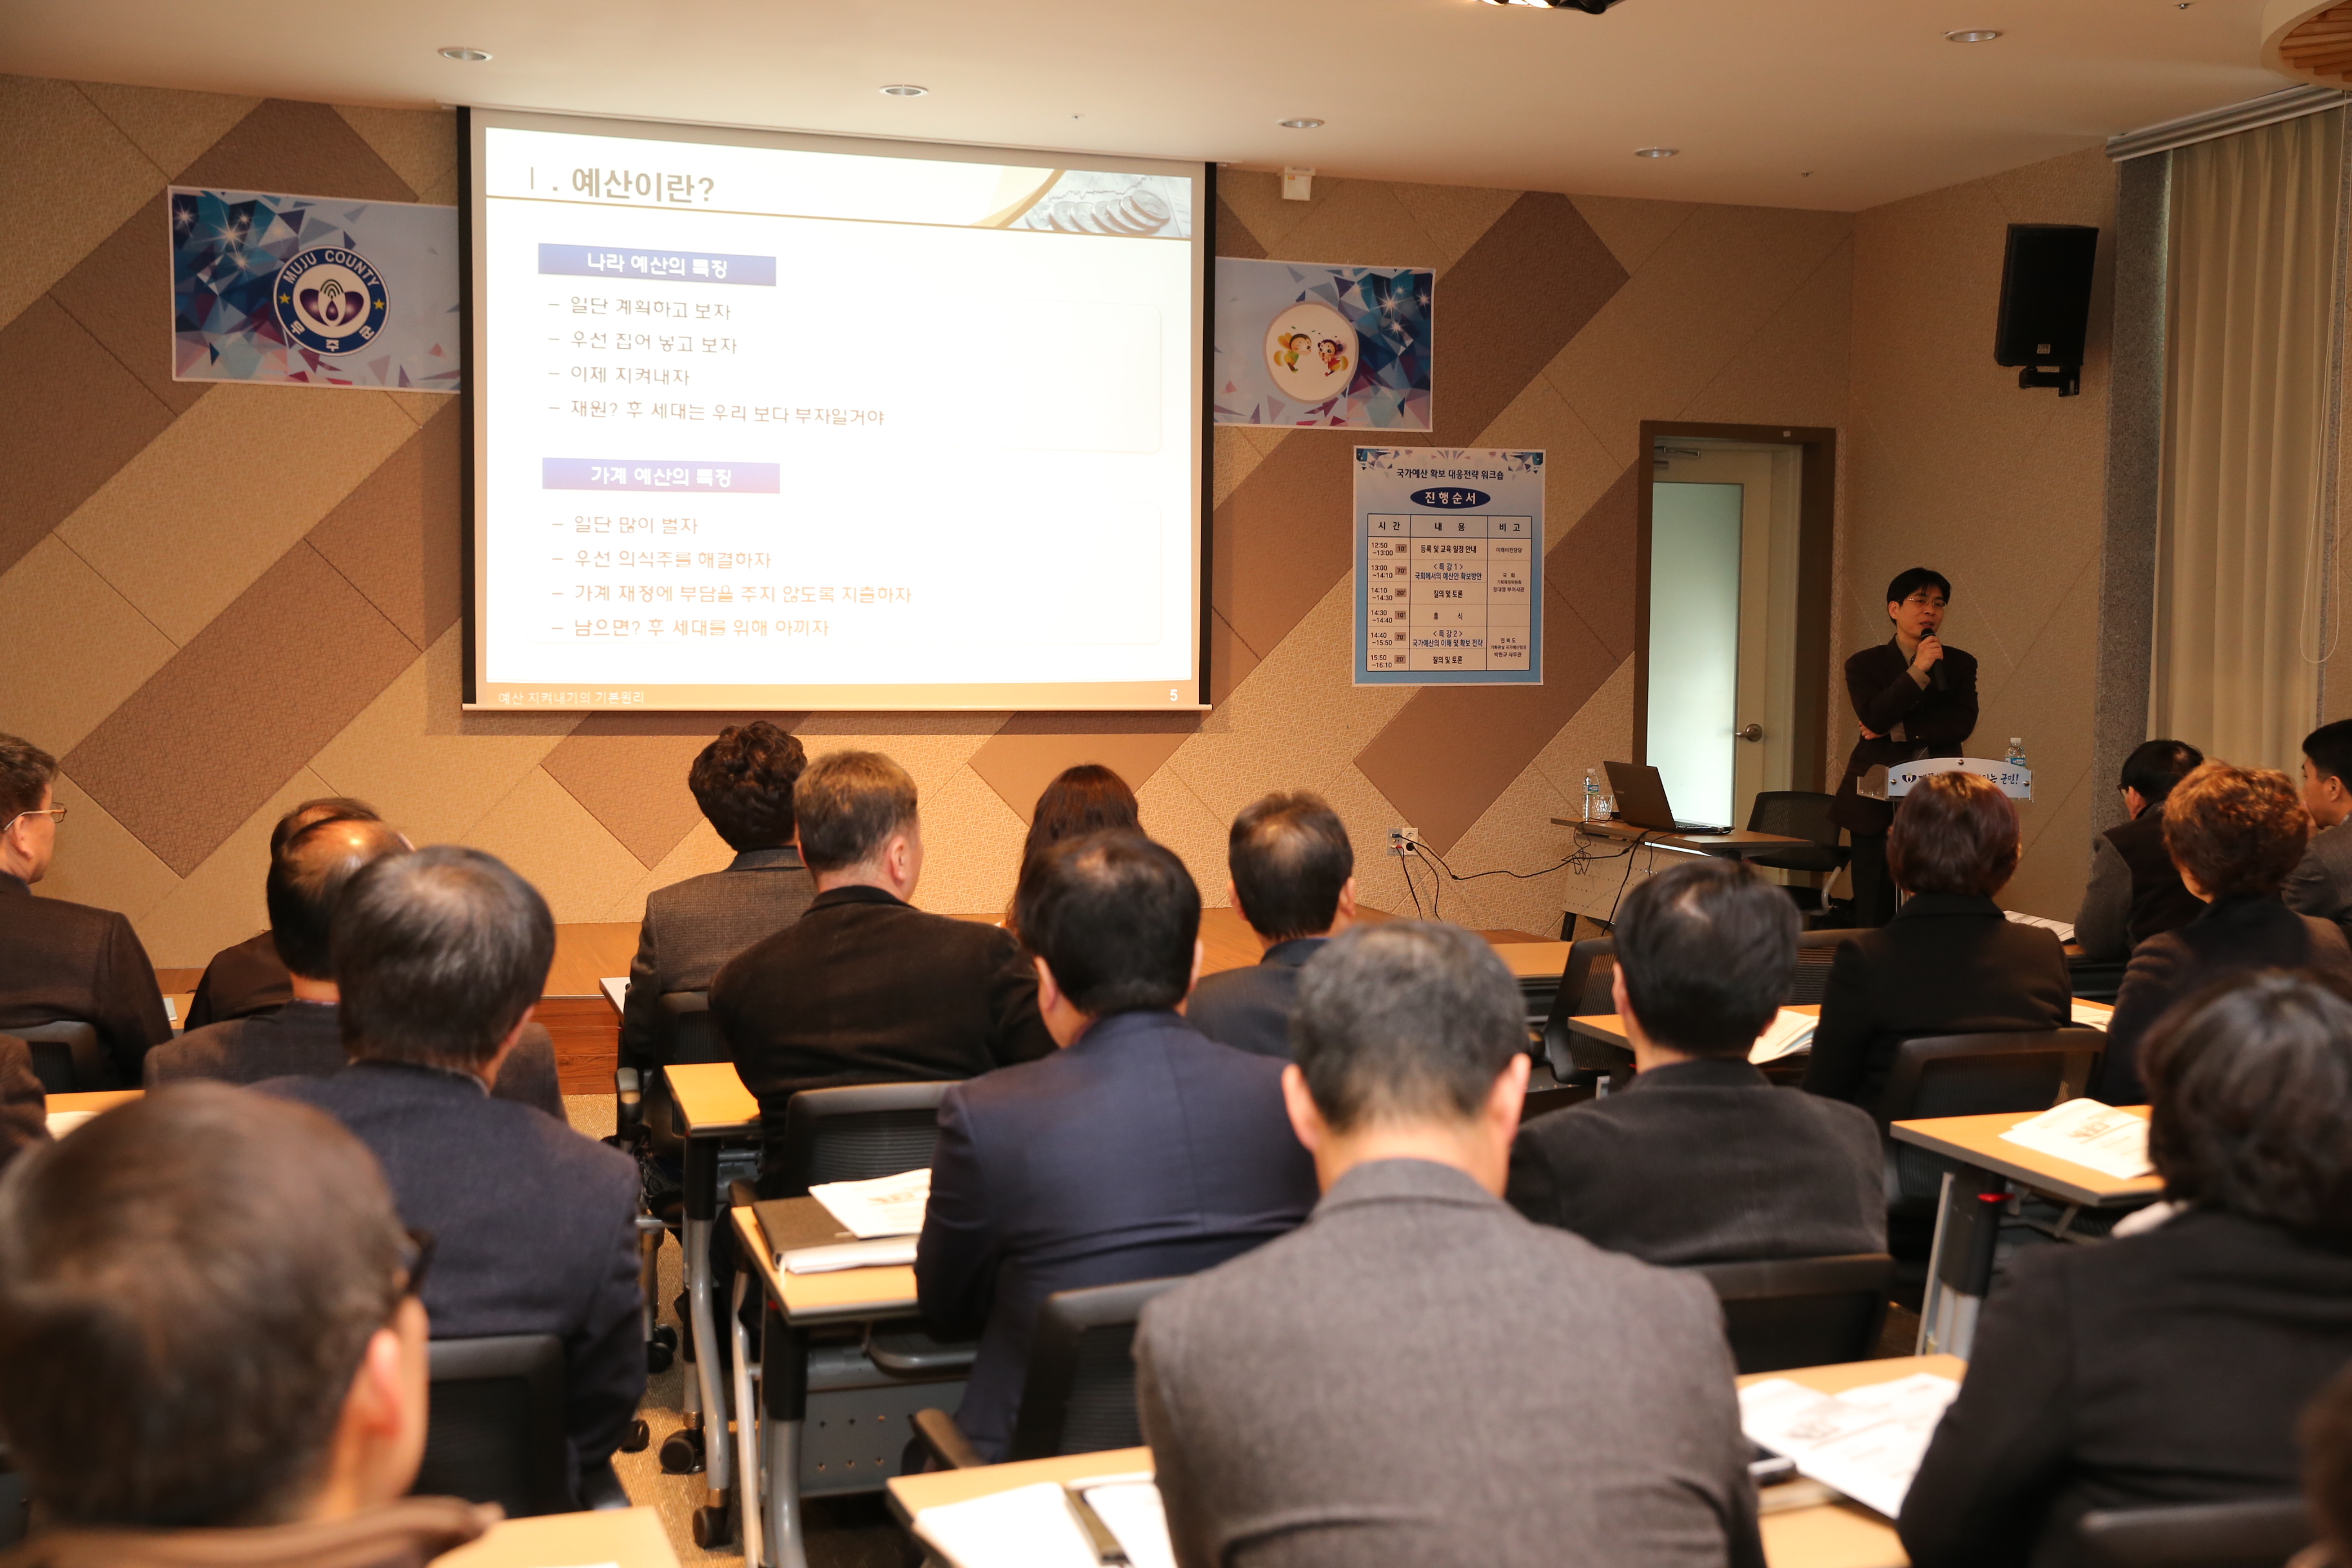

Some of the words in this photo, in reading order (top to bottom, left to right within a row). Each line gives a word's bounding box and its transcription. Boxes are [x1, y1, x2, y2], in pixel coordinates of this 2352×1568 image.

[572, 168, 715, 203] 예산이란?
[282, 251, 317, 284] MUJU
[324, 250, 380, 286] COUNTY
[587, 253, 625, 272] 나라
[631, 255, 686, 276] 예산의
[692, 259, 728, 279] 특징
[571, 296, 609, 315] 일단
[616, 299, 688, 318] 계획하고
[695, 303, 731, 320] 보자
[571, 331, 607, 349] 우선
[616, 333, 651, 350] 집어
[659, 335, 693, 352] 넣고
[701, 337, 737, 355] 보자
[571, 366, 606, 383] 이제
[616, 368, 690, 386] 지켜내자
[571, 400, 618, 418] 재원?
[626, 401, 643, 418] 후
[651, 402, 705, 420] 세대는
[712, 404, 746, 422] 우리
[754, 406, 789, 424] 보다
[796, 407, 885, 426] 부자일거야
[591, 466, 627, 485] 가계
[634, 467, 690, 487] 예산의
[696, 468, 732, 488] 특징
[1396, 469, 1428, 478] 국가예산
[1430, 469, 1446, 478] 확보
[1448, 469, 1479, 480] 대응전략
[1481, 470, 1504, 480] 워크숍
[574, 516, 612, 533] 일단
[619, 517, 654, 534] 많이
[662, 517, 698, 534] 벌자
[1420, 545, 1431, 553] 등록
[574, 550, 610, 567] 우선
[618, 551, 691, 568] 의식주를
[698, 552, 772, 569] 해결하자
[1415, 572, 1441, 580] 국회에서의
[575, 585, 610, 602] 가계
[618, 585, 672, 603] 재정에
[680, 585, 733, 603] 부담을
[741, 586, 775, 603] 주지
[783, 585, 835, 603] 않도록
[842, 586, 912, 603] 지출하자
[1433, 590, 1444, 598] 질의
[1452, 590, 1463, 598] 토론
[575, 619, 641, 636] 남으면?
[647, 618, 664, 636] 후
[672, 619, 726, 636] 세대를
[733, 619, 767, 637] 위해
[776, 620, 829, 636] 아끼자
[1413, 639, 1439, 647] 국가예산의
[1472, 639, 1483, 647] 전략
[498, 691, 524, 705] 예산
[527, 691, 591, 705] 지켜내기의
[595, 691, 645, 704] 기본원리
[1170, 689, 1178, 701] 5
[2000, 773, 2019, 785] 군민!
